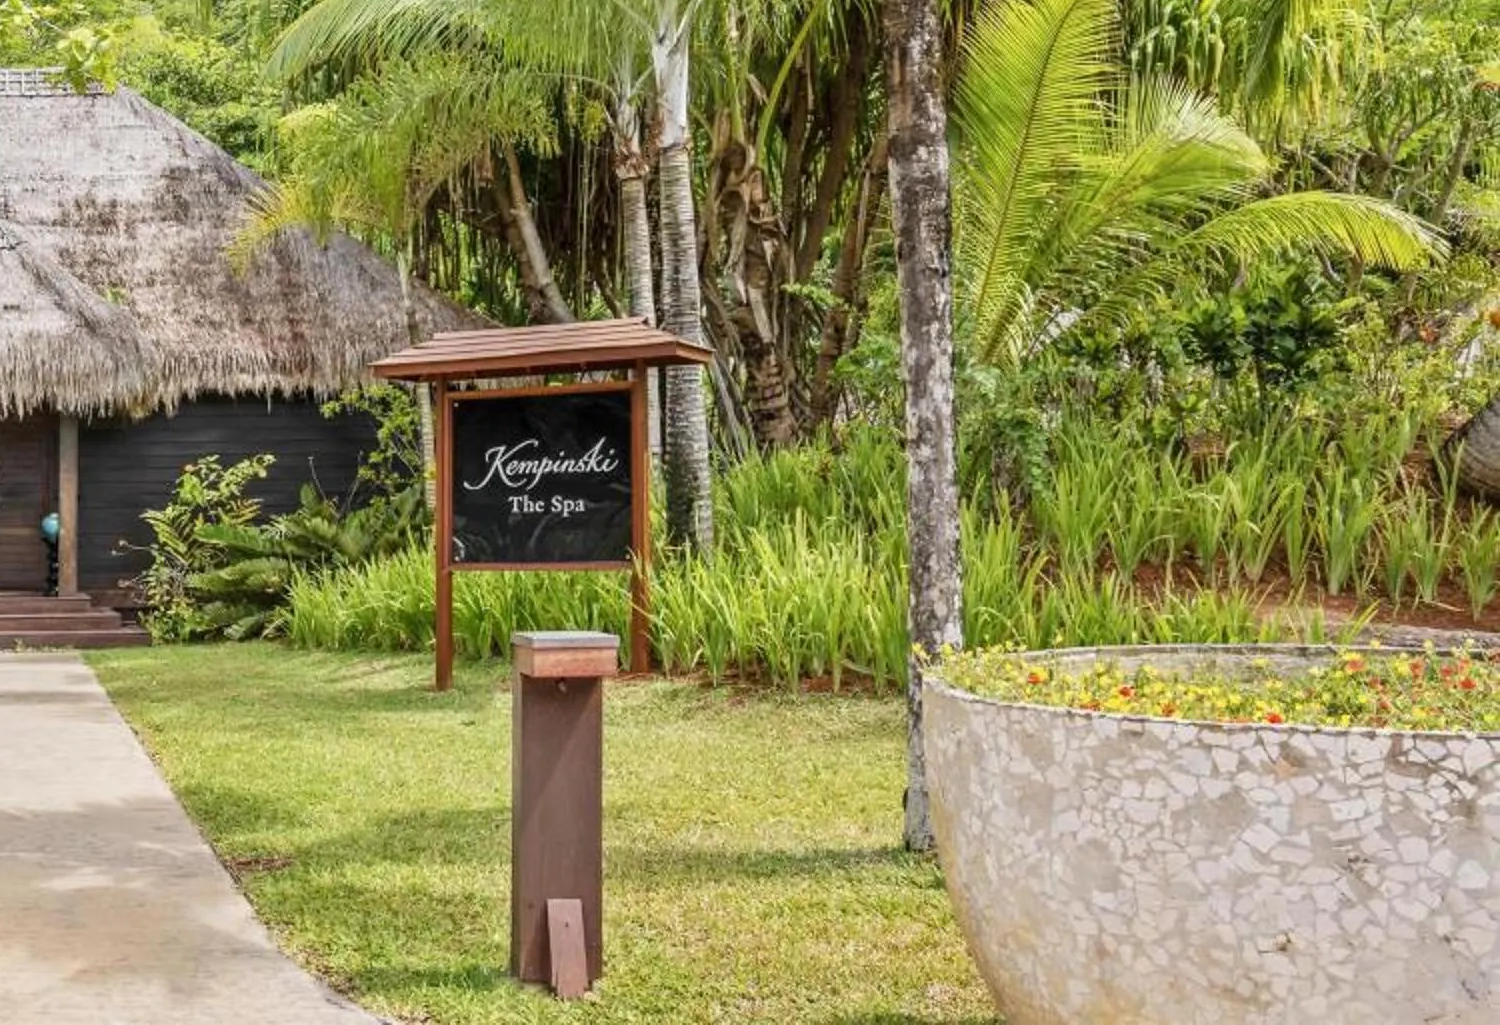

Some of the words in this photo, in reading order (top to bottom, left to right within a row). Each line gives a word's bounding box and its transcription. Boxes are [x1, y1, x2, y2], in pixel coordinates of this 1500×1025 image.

[463, 436, 619, 490] Kempinski
[508, 494, 545, 513] The
[551, 495, 585, 518] Spa
